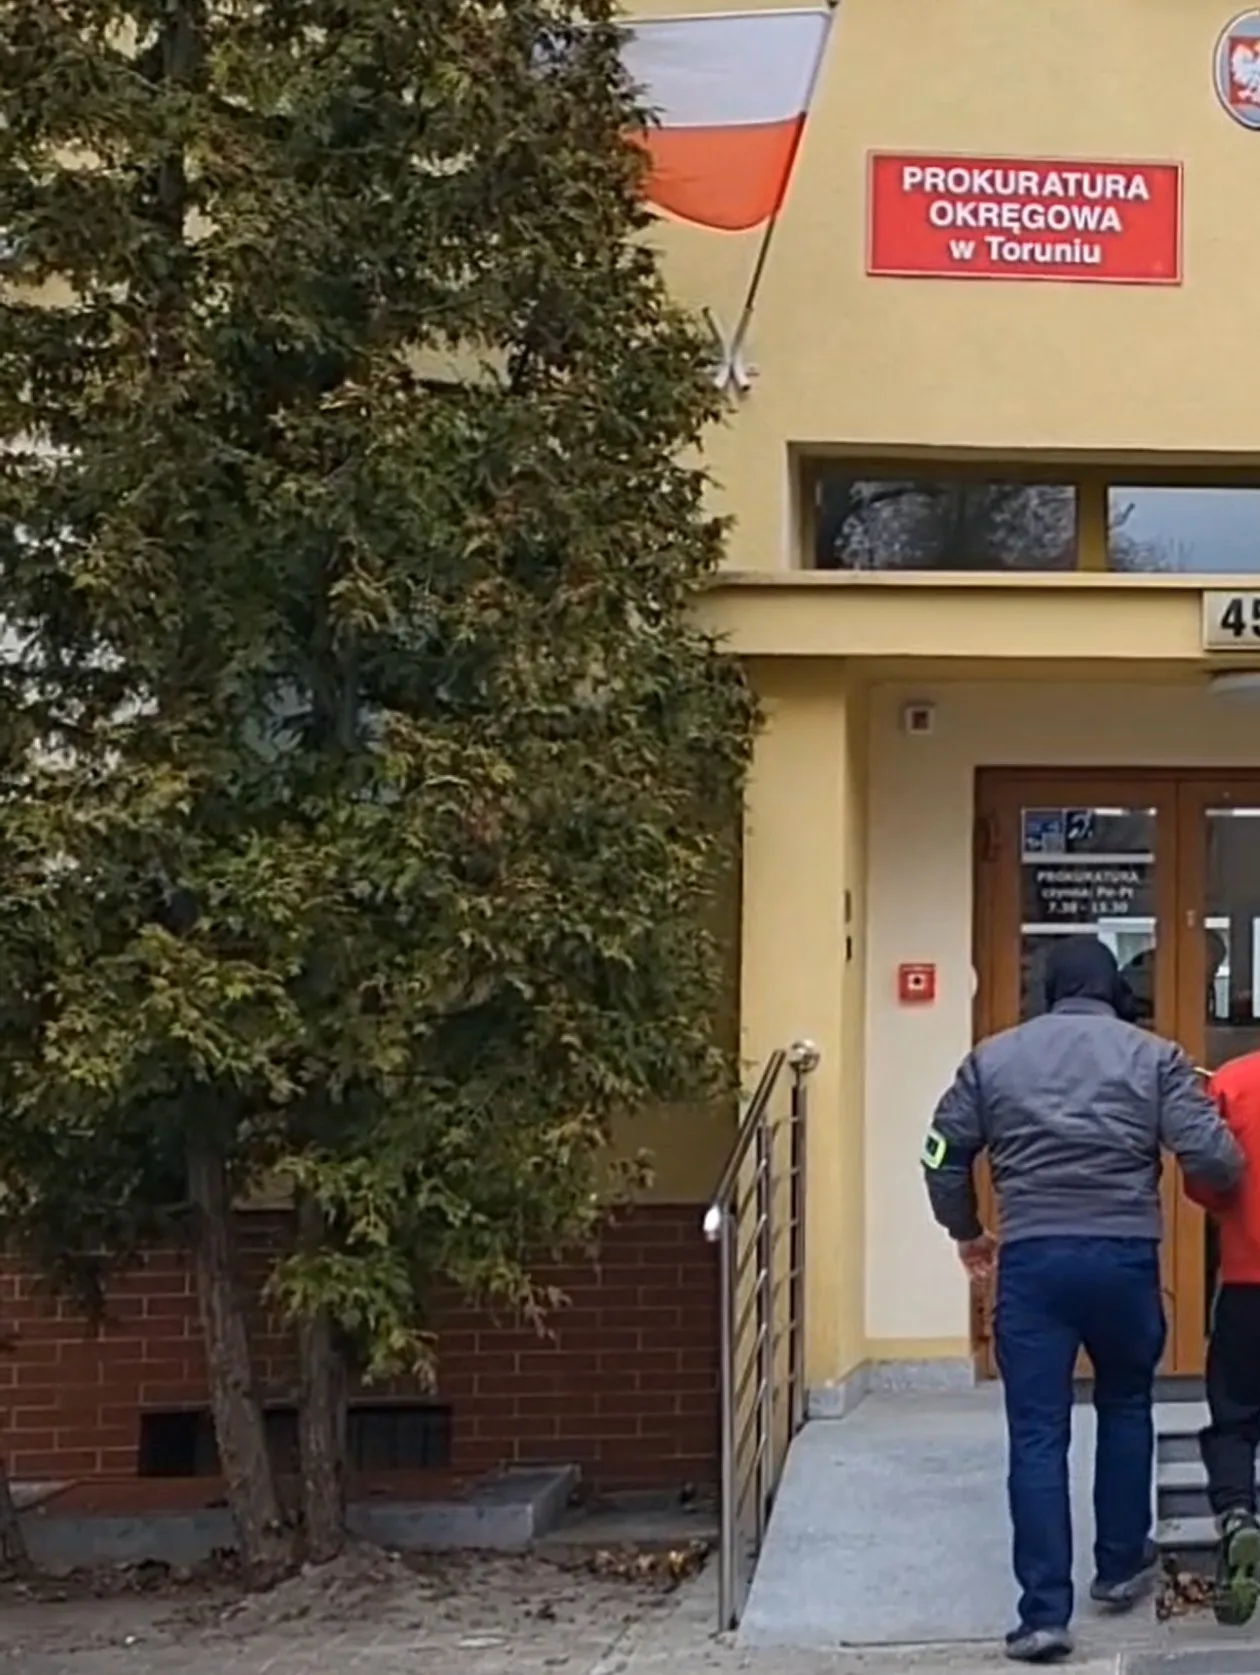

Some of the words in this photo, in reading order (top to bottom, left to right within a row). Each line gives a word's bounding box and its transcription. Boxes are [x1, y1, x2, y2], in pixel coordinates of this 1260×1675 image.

[902, 166, 1151, 200] PROKURATURA
[929, 200, 1123, 234] OKRĘGOWA
[949, 239, 975, 260] w
[985, 235, 1101, 264] Toruniu
